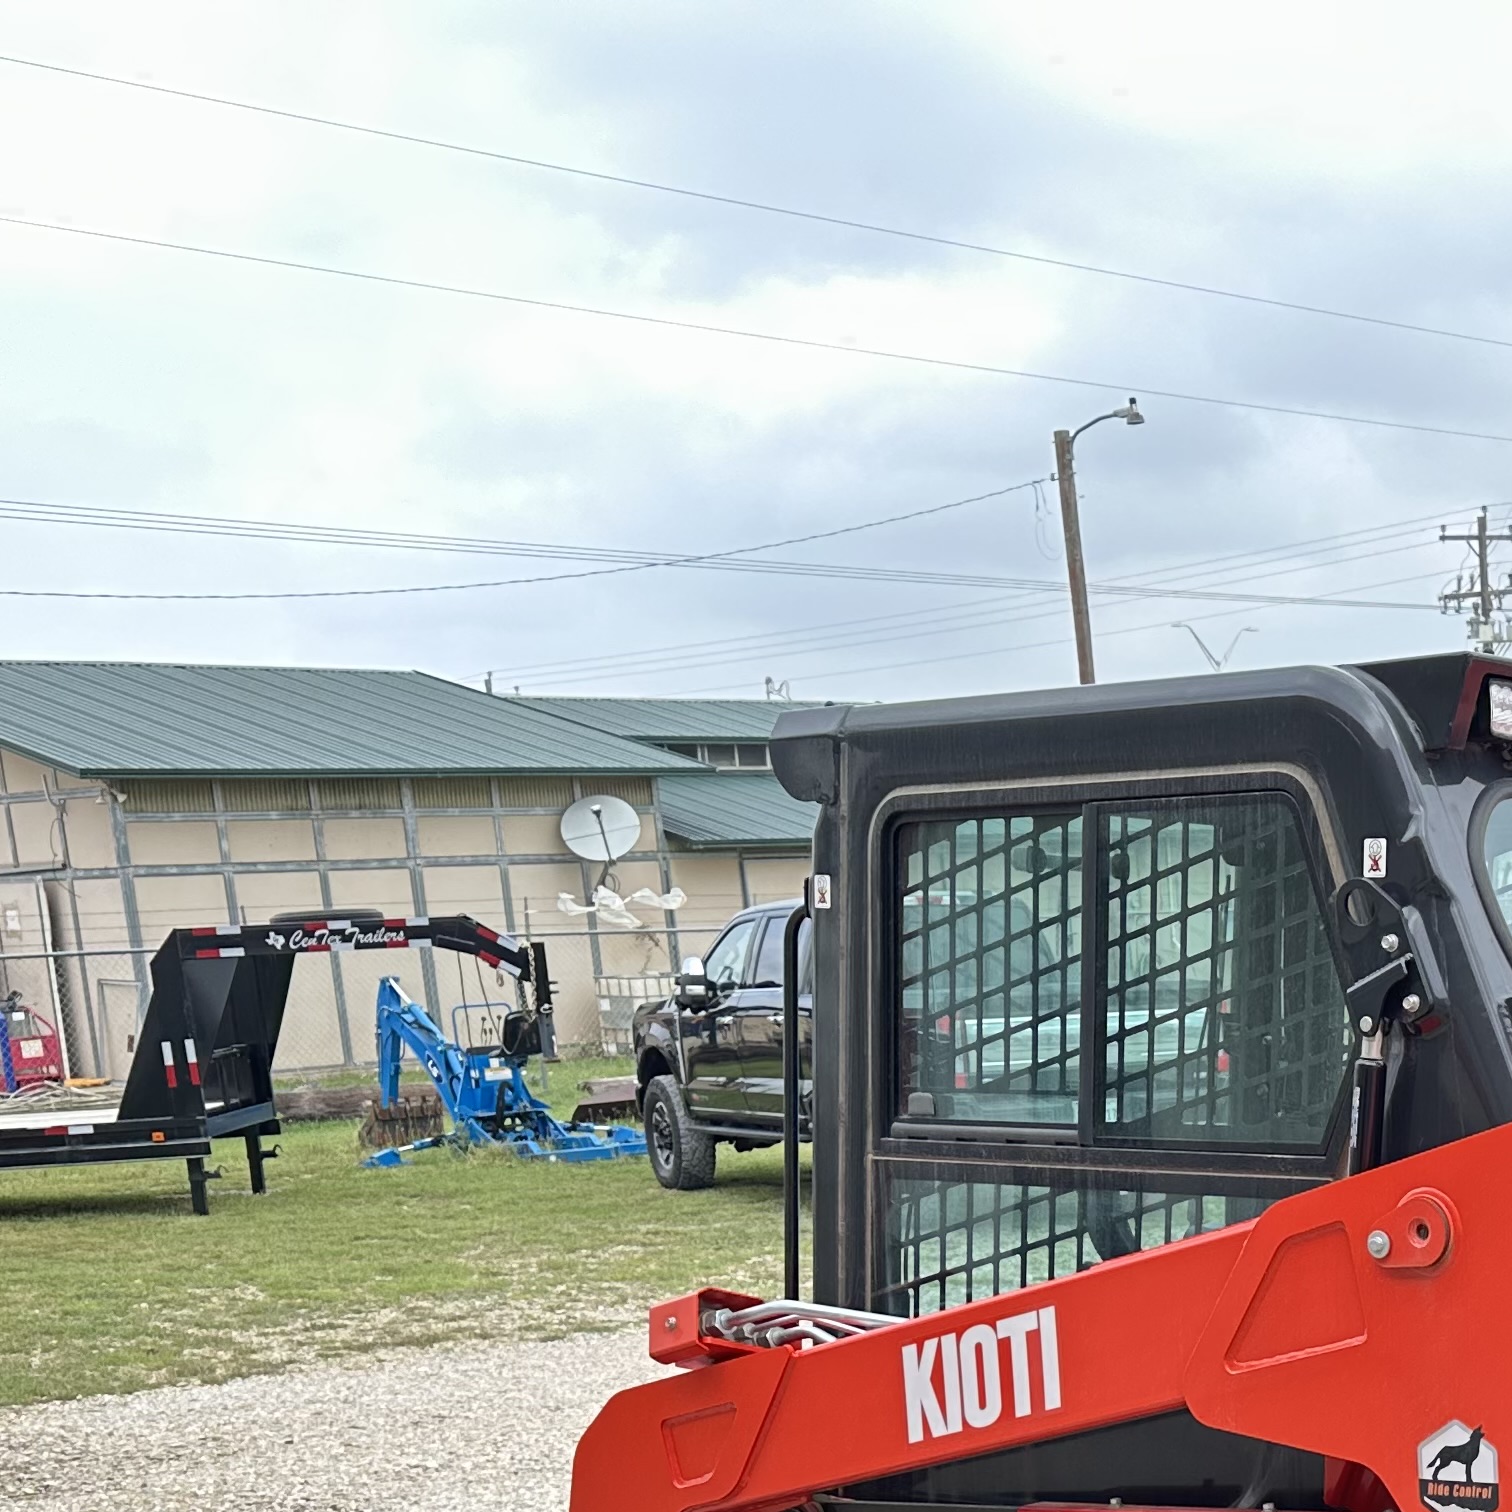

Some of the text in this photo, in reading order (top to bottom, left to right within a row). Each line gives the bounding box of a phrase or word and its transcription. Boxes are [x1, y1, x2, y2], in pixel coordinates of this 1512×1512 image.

[288, 927, 406, 949] CenTex Trailers
[902, 1305, 1062, 1444] KIOTI
[1427, 1482, 1493, 1499] Ride Control
